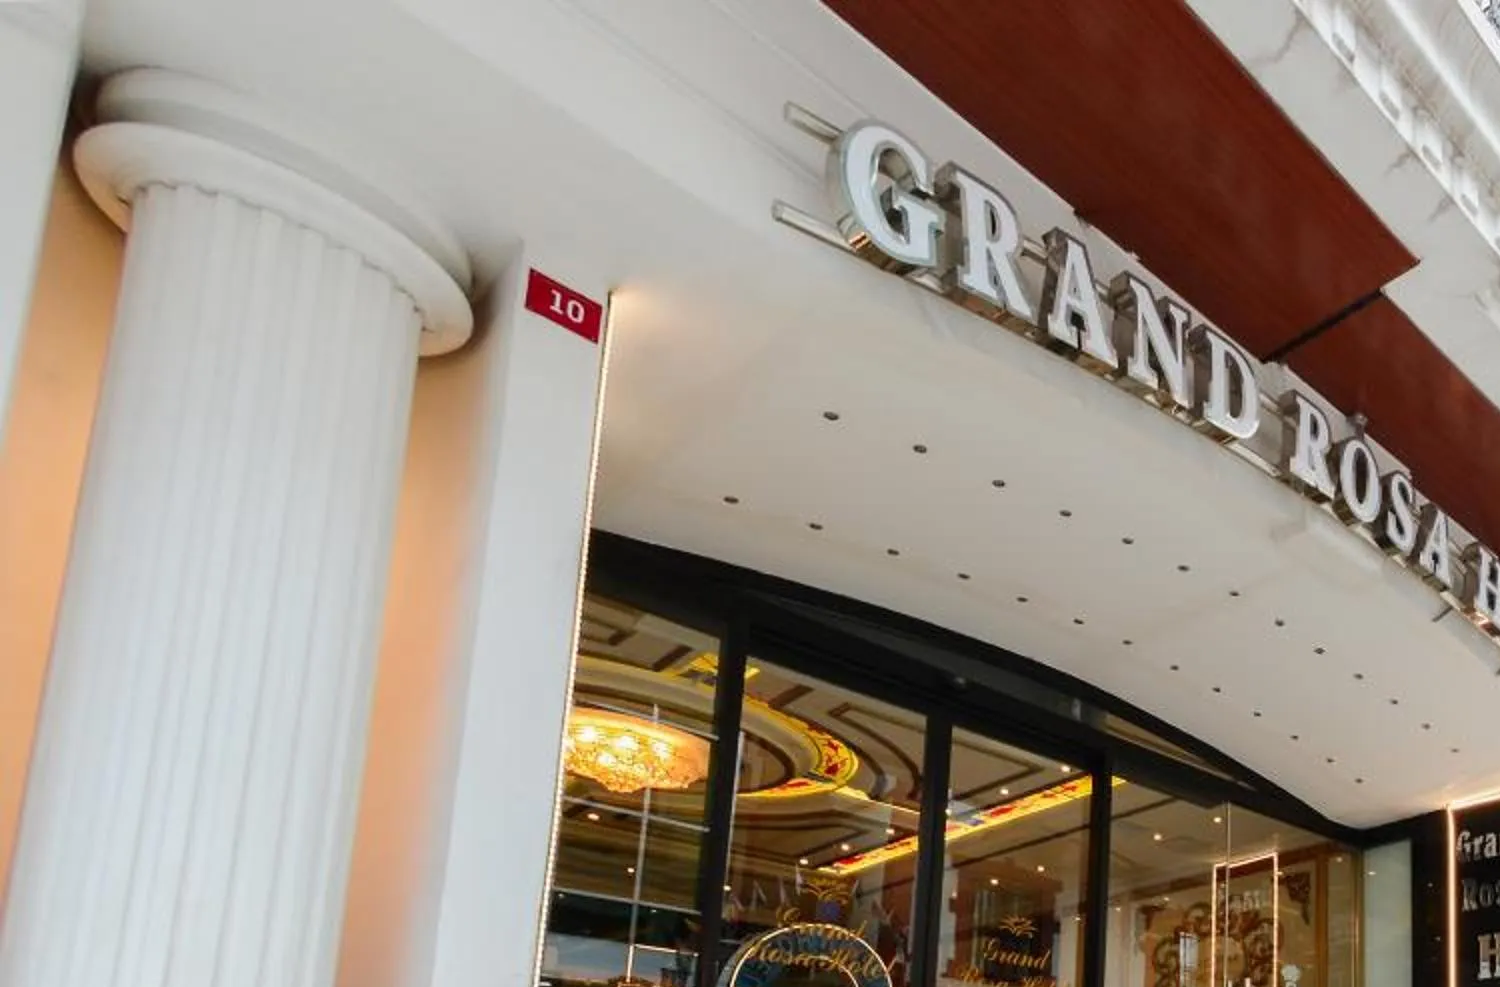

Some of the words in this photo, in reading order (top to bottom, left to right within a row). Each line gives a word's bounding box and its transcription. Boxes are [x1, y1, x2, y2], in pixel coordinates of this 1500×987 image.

[549, 288, 585, 323] 10
[842, 122, 1261, 441] GRAND
[1289, 395, 1455, 591] ROSA
